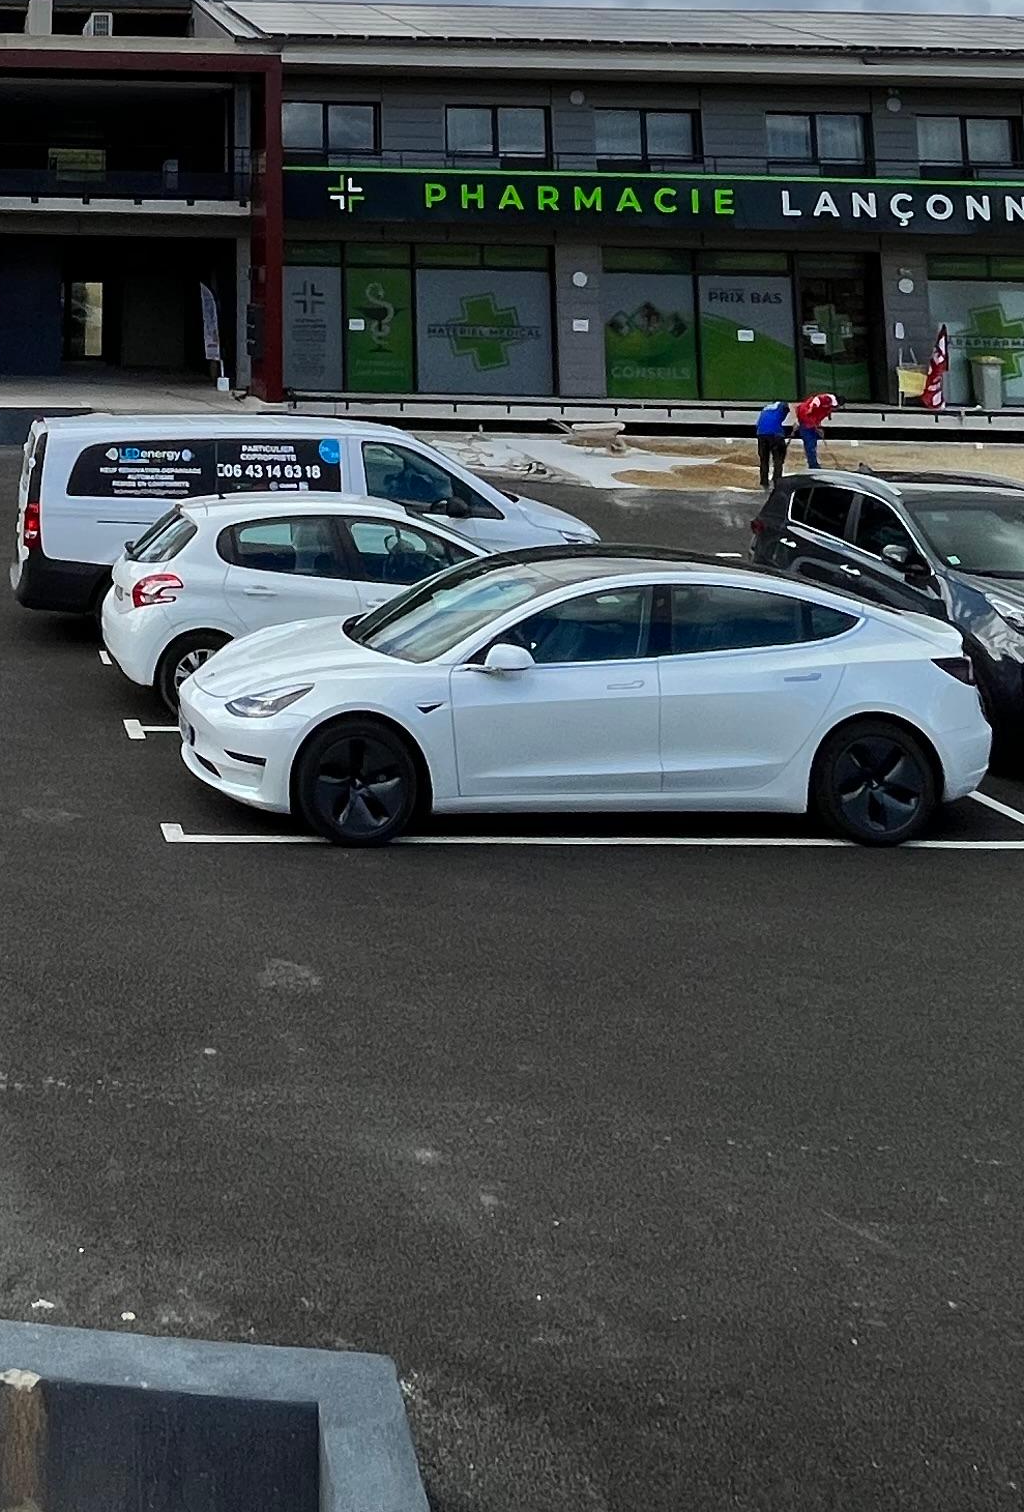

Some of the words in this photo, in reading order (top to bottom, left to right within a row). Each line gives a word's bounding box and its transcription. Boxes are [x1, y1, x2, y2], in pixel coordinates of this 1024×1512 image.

[425, 184, 735, 215] PHARMACIE
[708, 291, 745, 304] PRIX
[750, 292, 783, 305] BAS
[610, 366, 691, 380] CONSEILS
[223, 463, 242, 478] 06
[245, 464, 263, 478] 43
[266, 464, 282, 478] 14
[284, 464, 302, 478] 63
[304, 464, 321, 479] 18
